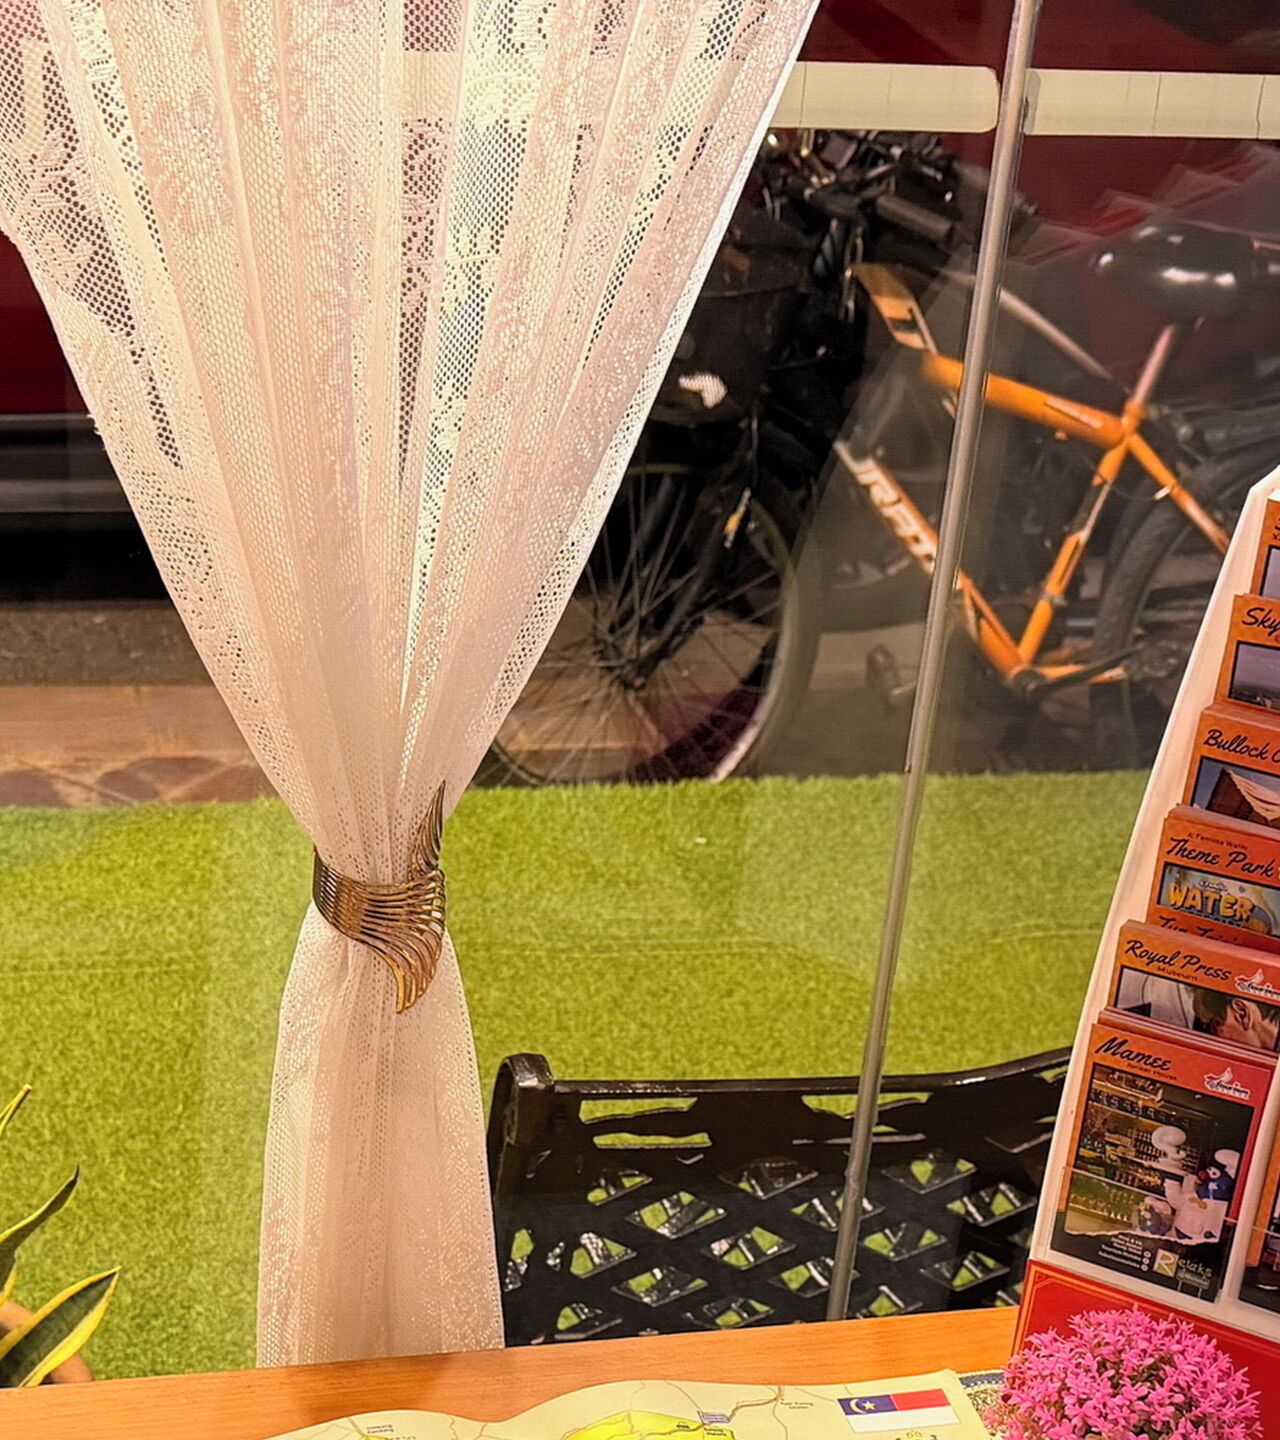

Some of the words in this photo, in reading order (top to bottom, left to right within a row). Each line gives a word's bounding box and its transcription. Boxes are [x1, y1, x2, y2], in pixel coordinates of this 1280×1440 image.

[1203, 729, 1268, 761] Bullock
[1167, 838, 1219, 865] Theme
[1223, 851, 1273, 877] Park
[1125, 940, 1180, 967] Royal
[1181, 955, 1232, 981] Press
[1095, 1037, 1171, 1070] Mamee
